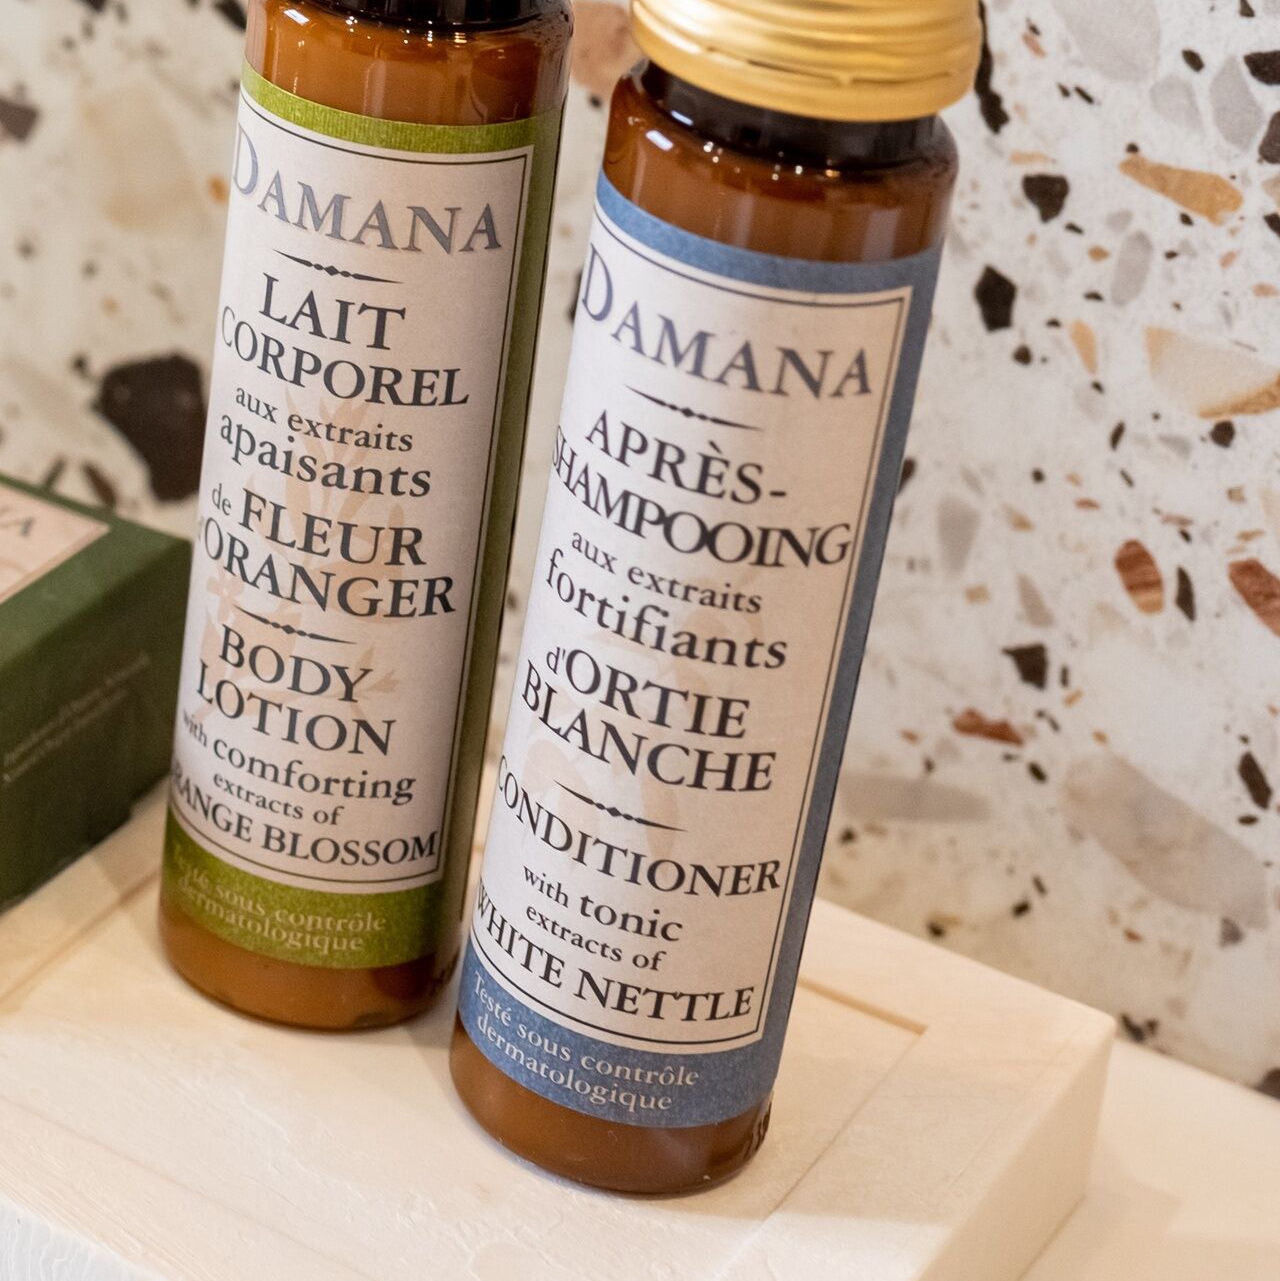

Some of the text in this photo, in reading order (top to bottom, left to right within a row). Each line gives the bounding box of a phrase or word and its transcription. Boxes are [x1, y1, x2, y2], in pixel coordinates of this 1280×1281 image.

[233, 123, 502, 255] DAMANA
[221, 306, 469, 407] CORPOREL
[258, 272, 406, 350] LAIT
[582, 243, 872, 399] DAMANA
[220, 414, 431, 498] apaisants
[236, 387, 413, 452] aux extraits
[586, 410, 788, 505] APRÈS-
[212, 483, 426, 566] de FLEUR
[553, 425, 851, 568] SHAMPOOING
[546, 548, 788, 669] fortifiants
[571, 531, 762, 614] aux extraits
[197, 660, 396, 755] LOTION
[218, 624, 373, 704] BODY
[547, 646, 750, 739] d'ORTIE
[213, 738, 417, 805] comforting
[522, 659, 777, 792] BLANCHE
[213, 773, 344, 827] extracts of
[261, 823, 439, 866] BLOSSOM
[497, 755, 782, 899] CONDITIONER
[215, 884, 266, 916] sous
[274, 908, 386, 933] contrôle
[477, 877, 755, 1023] WHITE NETTLE
[523, 865, 683, 943] with tonic
[526, 905, 666, 972] extracts of
[474, 971, 700, 1087] Testé sous contrôle
[477, 1010, 672, 1113] dermatologique
